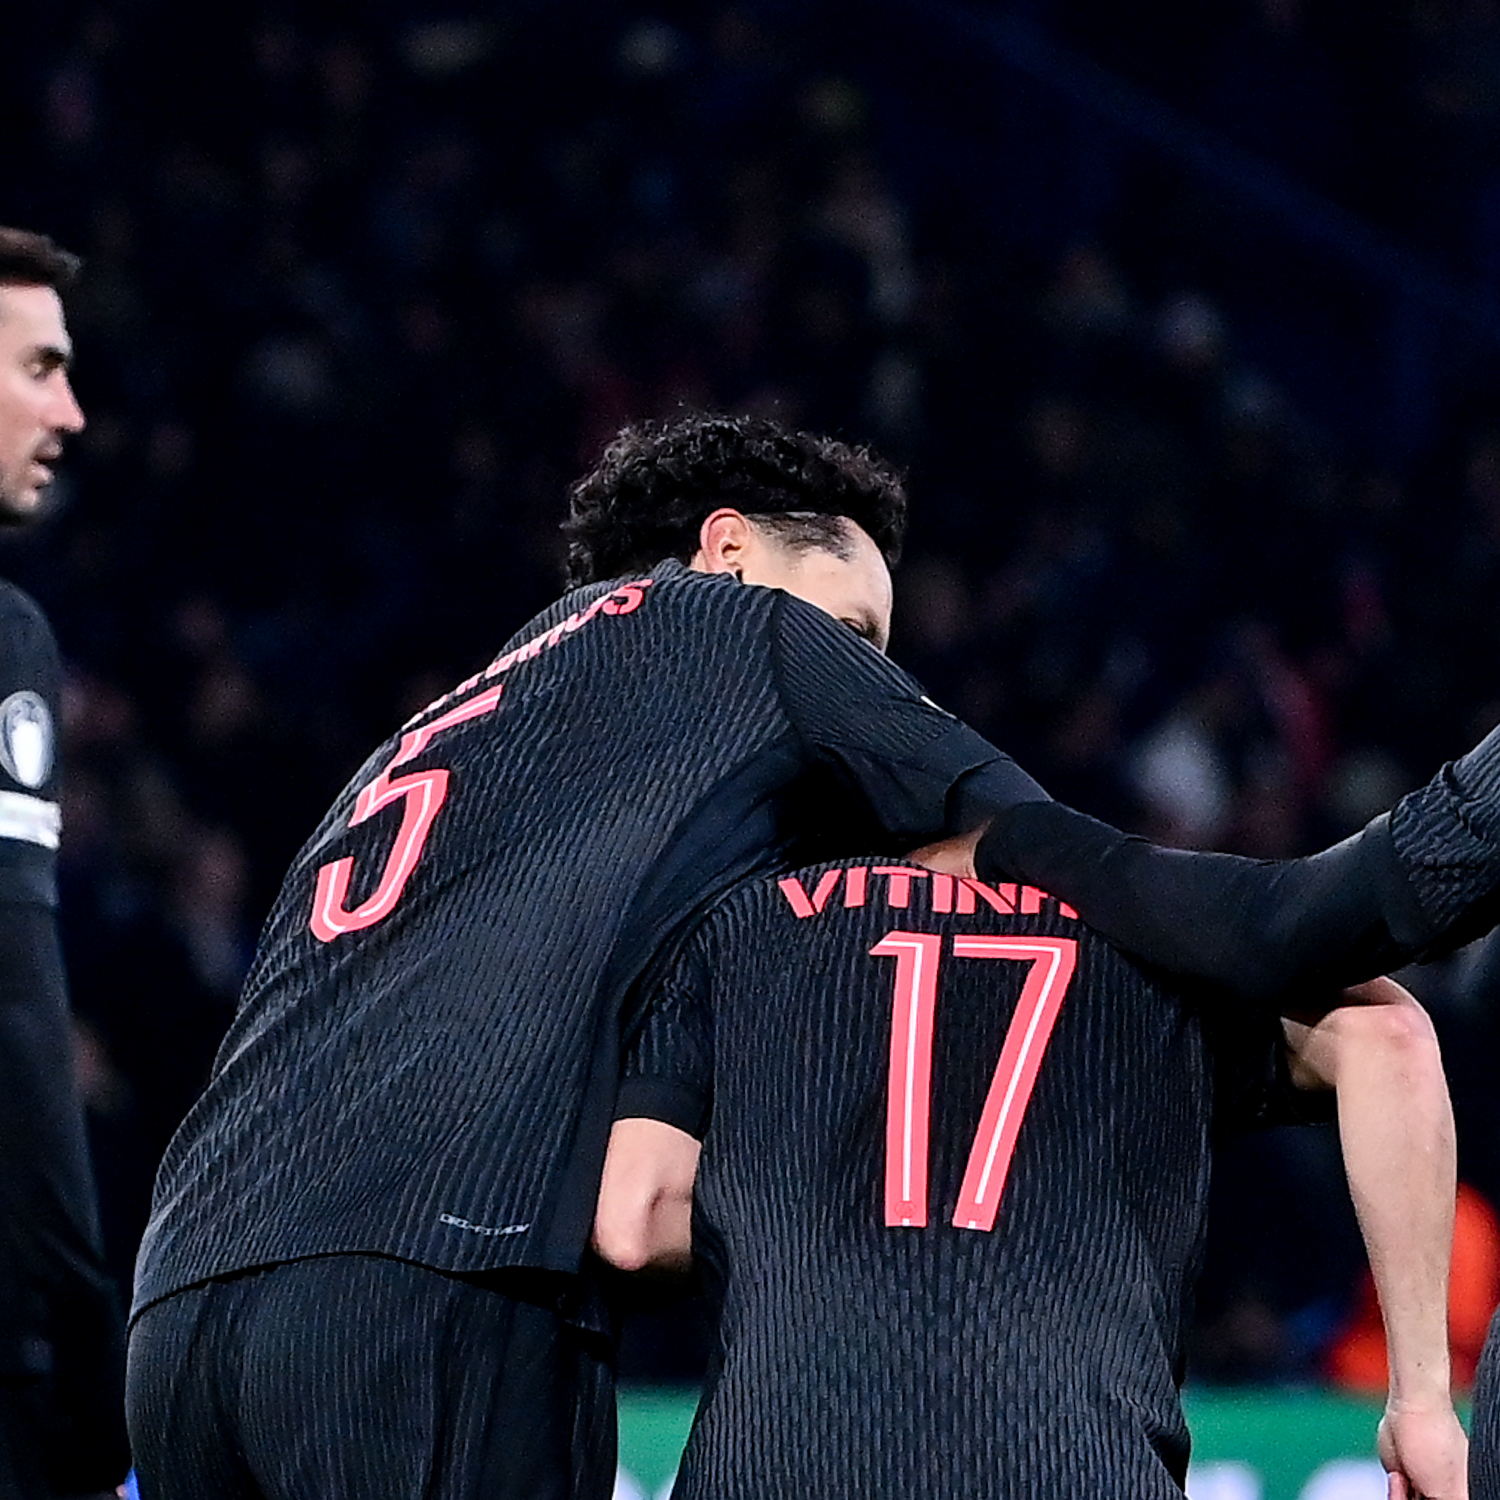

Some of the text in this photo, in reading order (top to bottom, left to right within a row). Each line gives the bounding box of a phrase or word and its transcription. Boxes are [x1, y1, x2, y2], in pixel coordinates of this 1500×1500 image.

[311, 684, 503, 942] 5
[778, 865, 1079, 919] VITIN
[869, 931, 1078, 1232] 17
